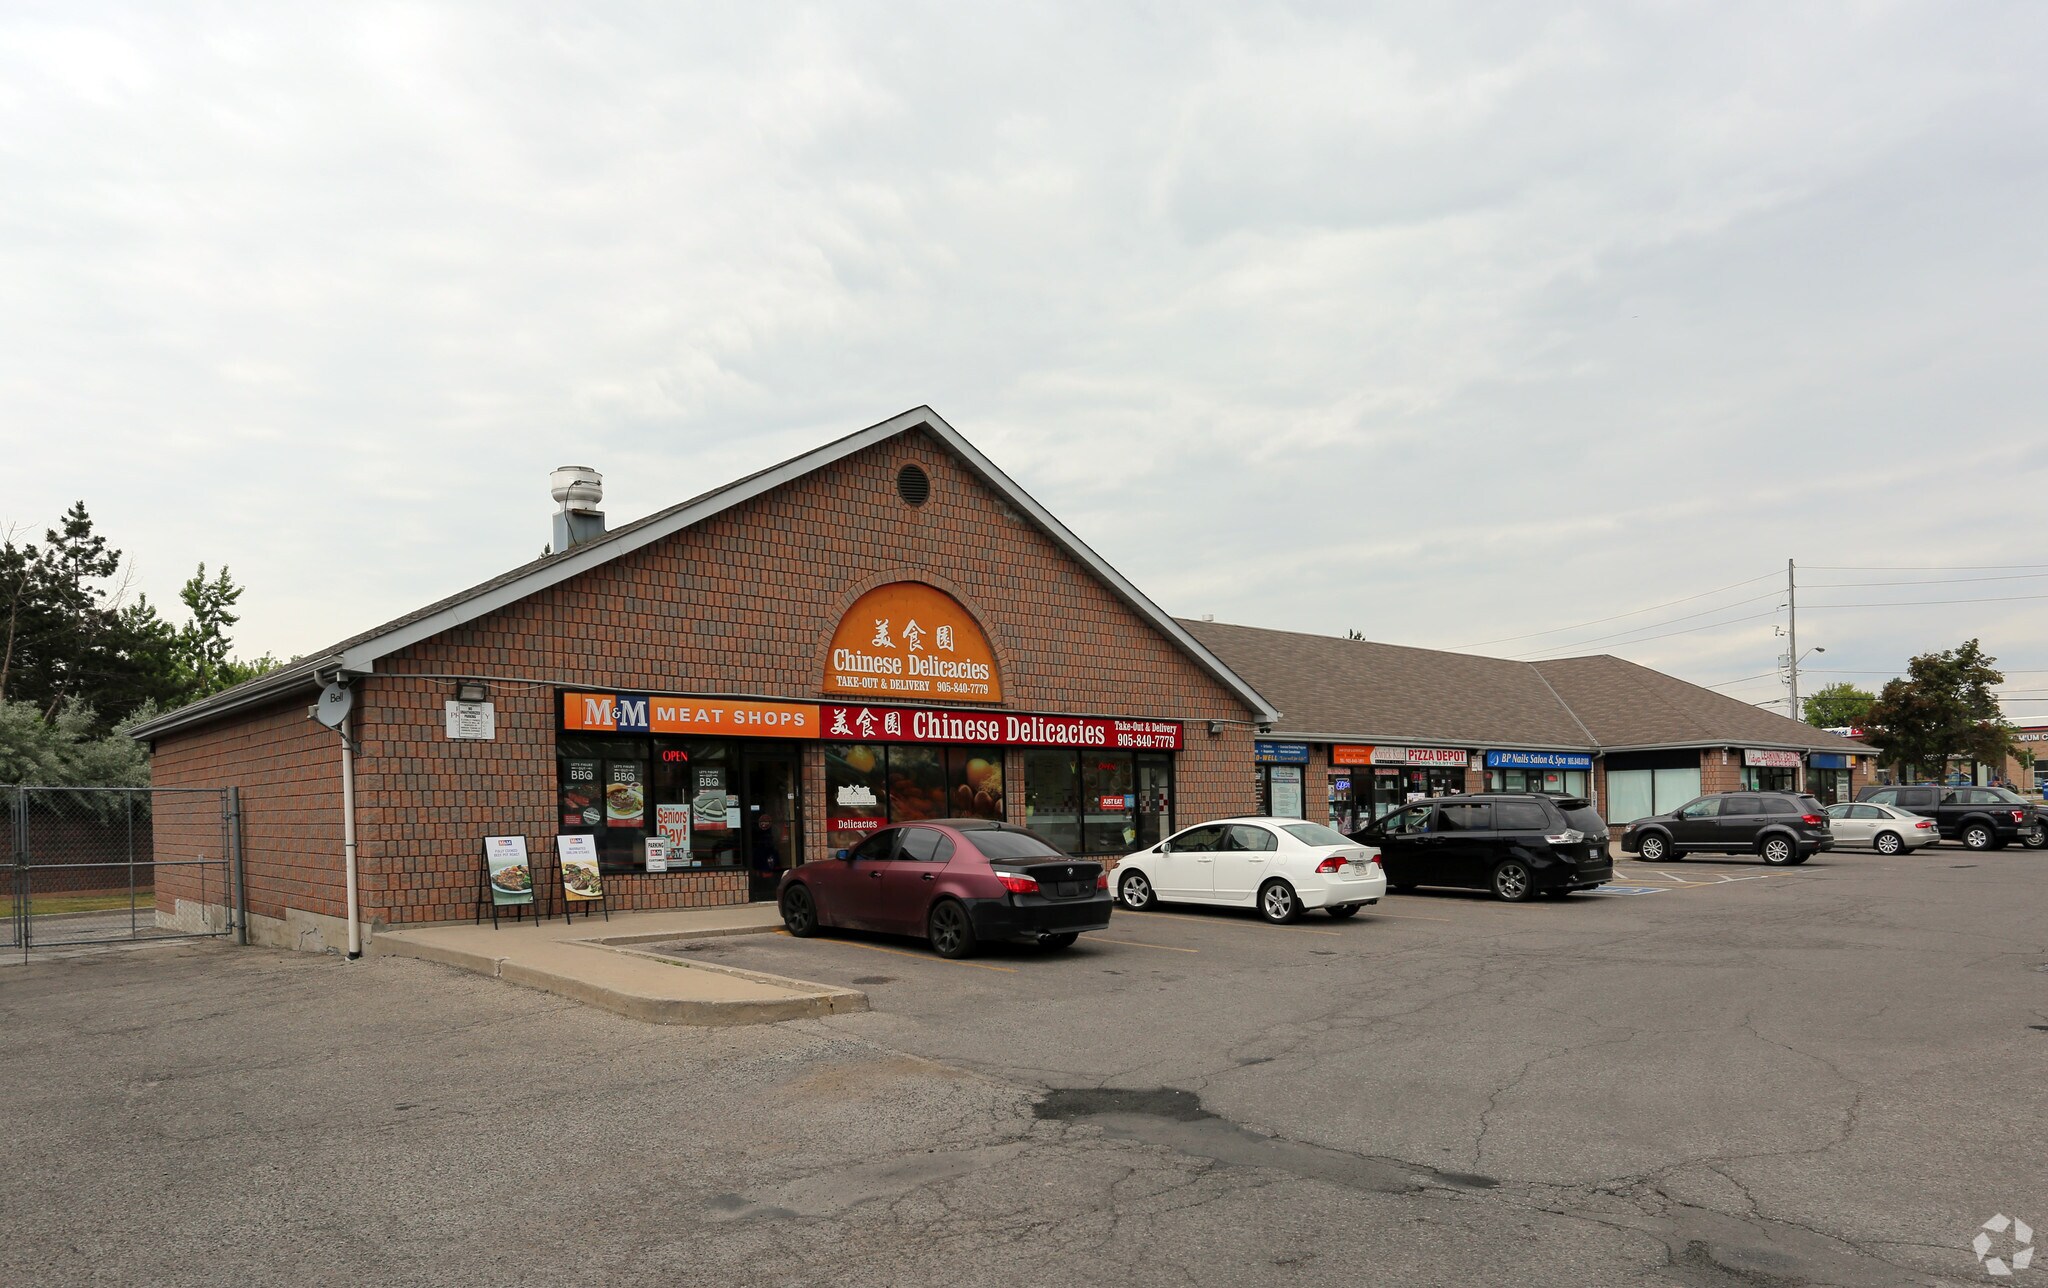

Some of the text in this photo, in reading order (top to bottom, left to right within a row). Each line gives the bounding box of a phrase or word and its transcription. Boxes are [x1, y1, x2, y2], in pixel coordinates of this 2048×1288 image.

[833, 648, 990, 680] Chinese Delicacies
[836, 675, 989, 695] TAKE-OUT & DELIVERY 905-840-7779
[330, 693, 344, 703] Bell
[584, 698, 805, 727] M&M MEAT SHOPS
[913, 711, 999, 741] Chinese
[1006, 716, 1105, 745] Delicacies
[1114, 720, 1177, 734] Take-Out & Delivery
[1117, 733, 1175, 748] 905-840-7779
[662, 750, 688, 762] OPEN
[1436, 750, 1465, 762] DEPOT
[1501, 753, 1512, 763] BP
[1512, 753, 1529, 764] Nails
[1530, 754, 1547, 764] Salon
[1548, 755, 1554, 765] &
[1555, 755, 1566, 766] Spa
[571, 770, 593, 780] BBQ
[614, 772, 635, 781] BBQ
[699, 778, 719, 787] BBQ
[657, 807, 689, 824] Seniors'
[838, 819, 878, 829] Delicacies
[659, 825, 687, 847] Day!
